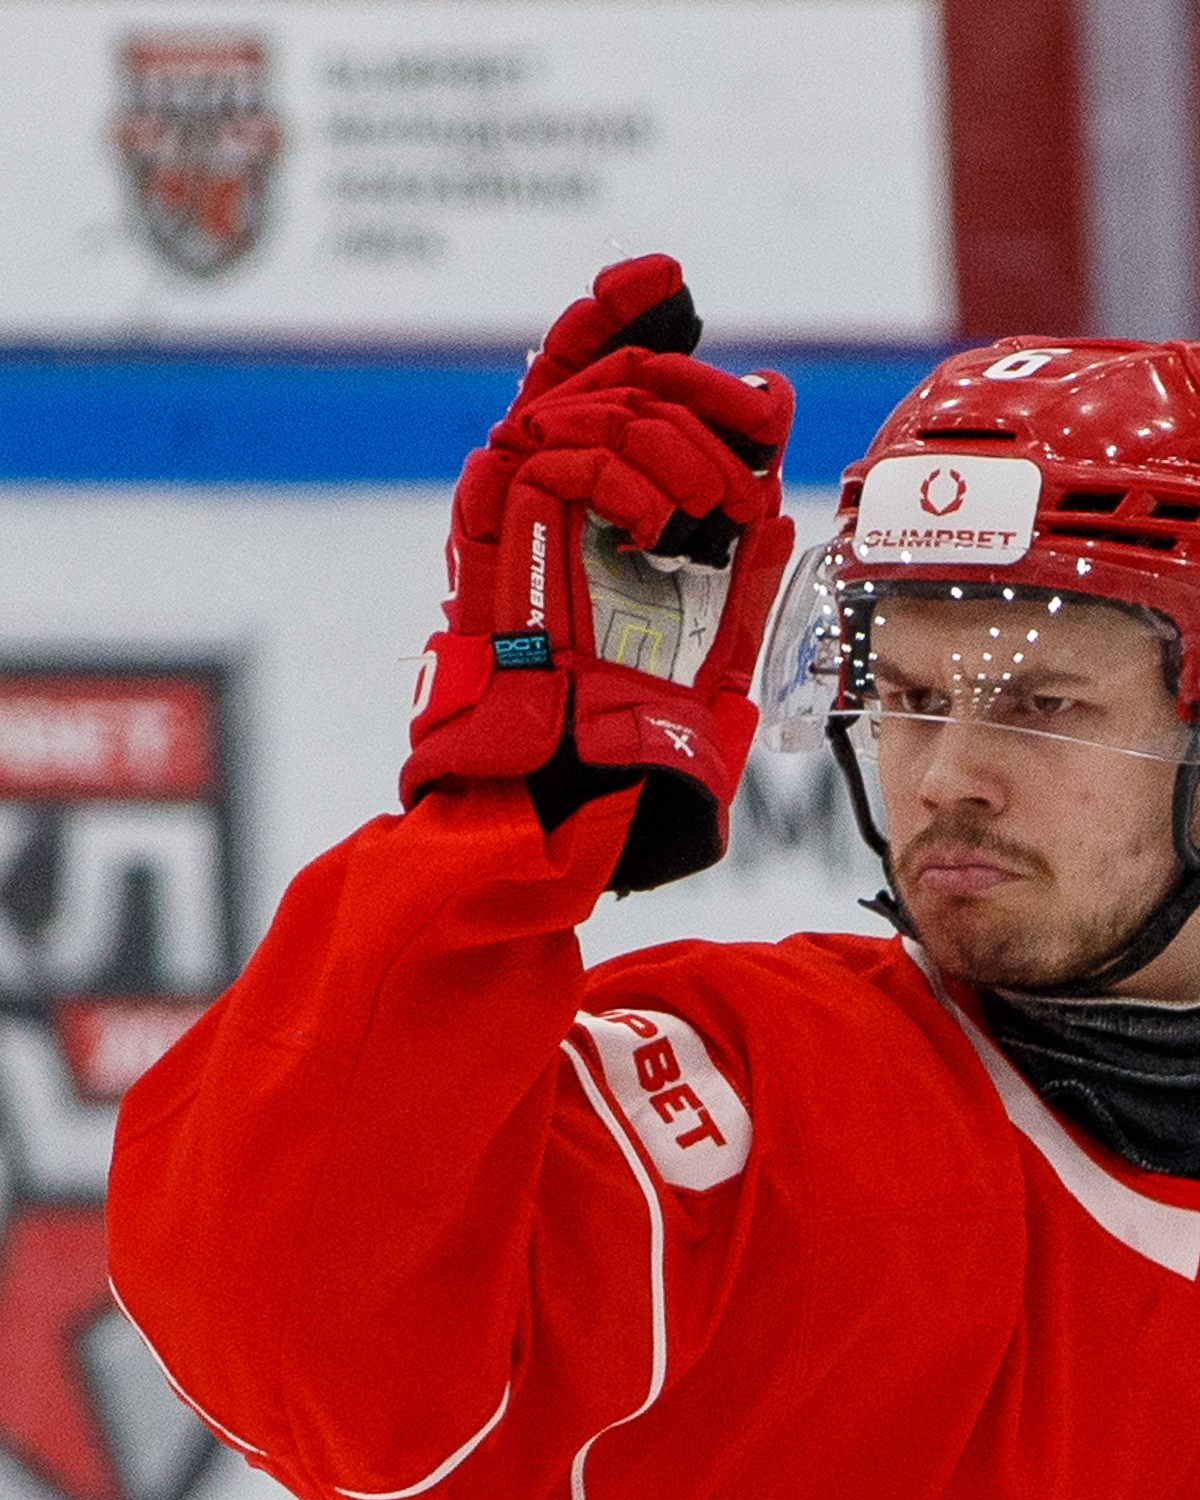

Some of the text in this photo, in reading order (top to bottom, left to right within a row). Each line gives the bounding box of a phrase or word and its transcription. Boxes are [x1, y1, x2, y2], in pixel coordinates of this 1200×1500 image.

[982, 348, 1073, 380] 6
[864, 530, 1017, 549] OLIMPBET
[495, 636, 545, 653] DCT
